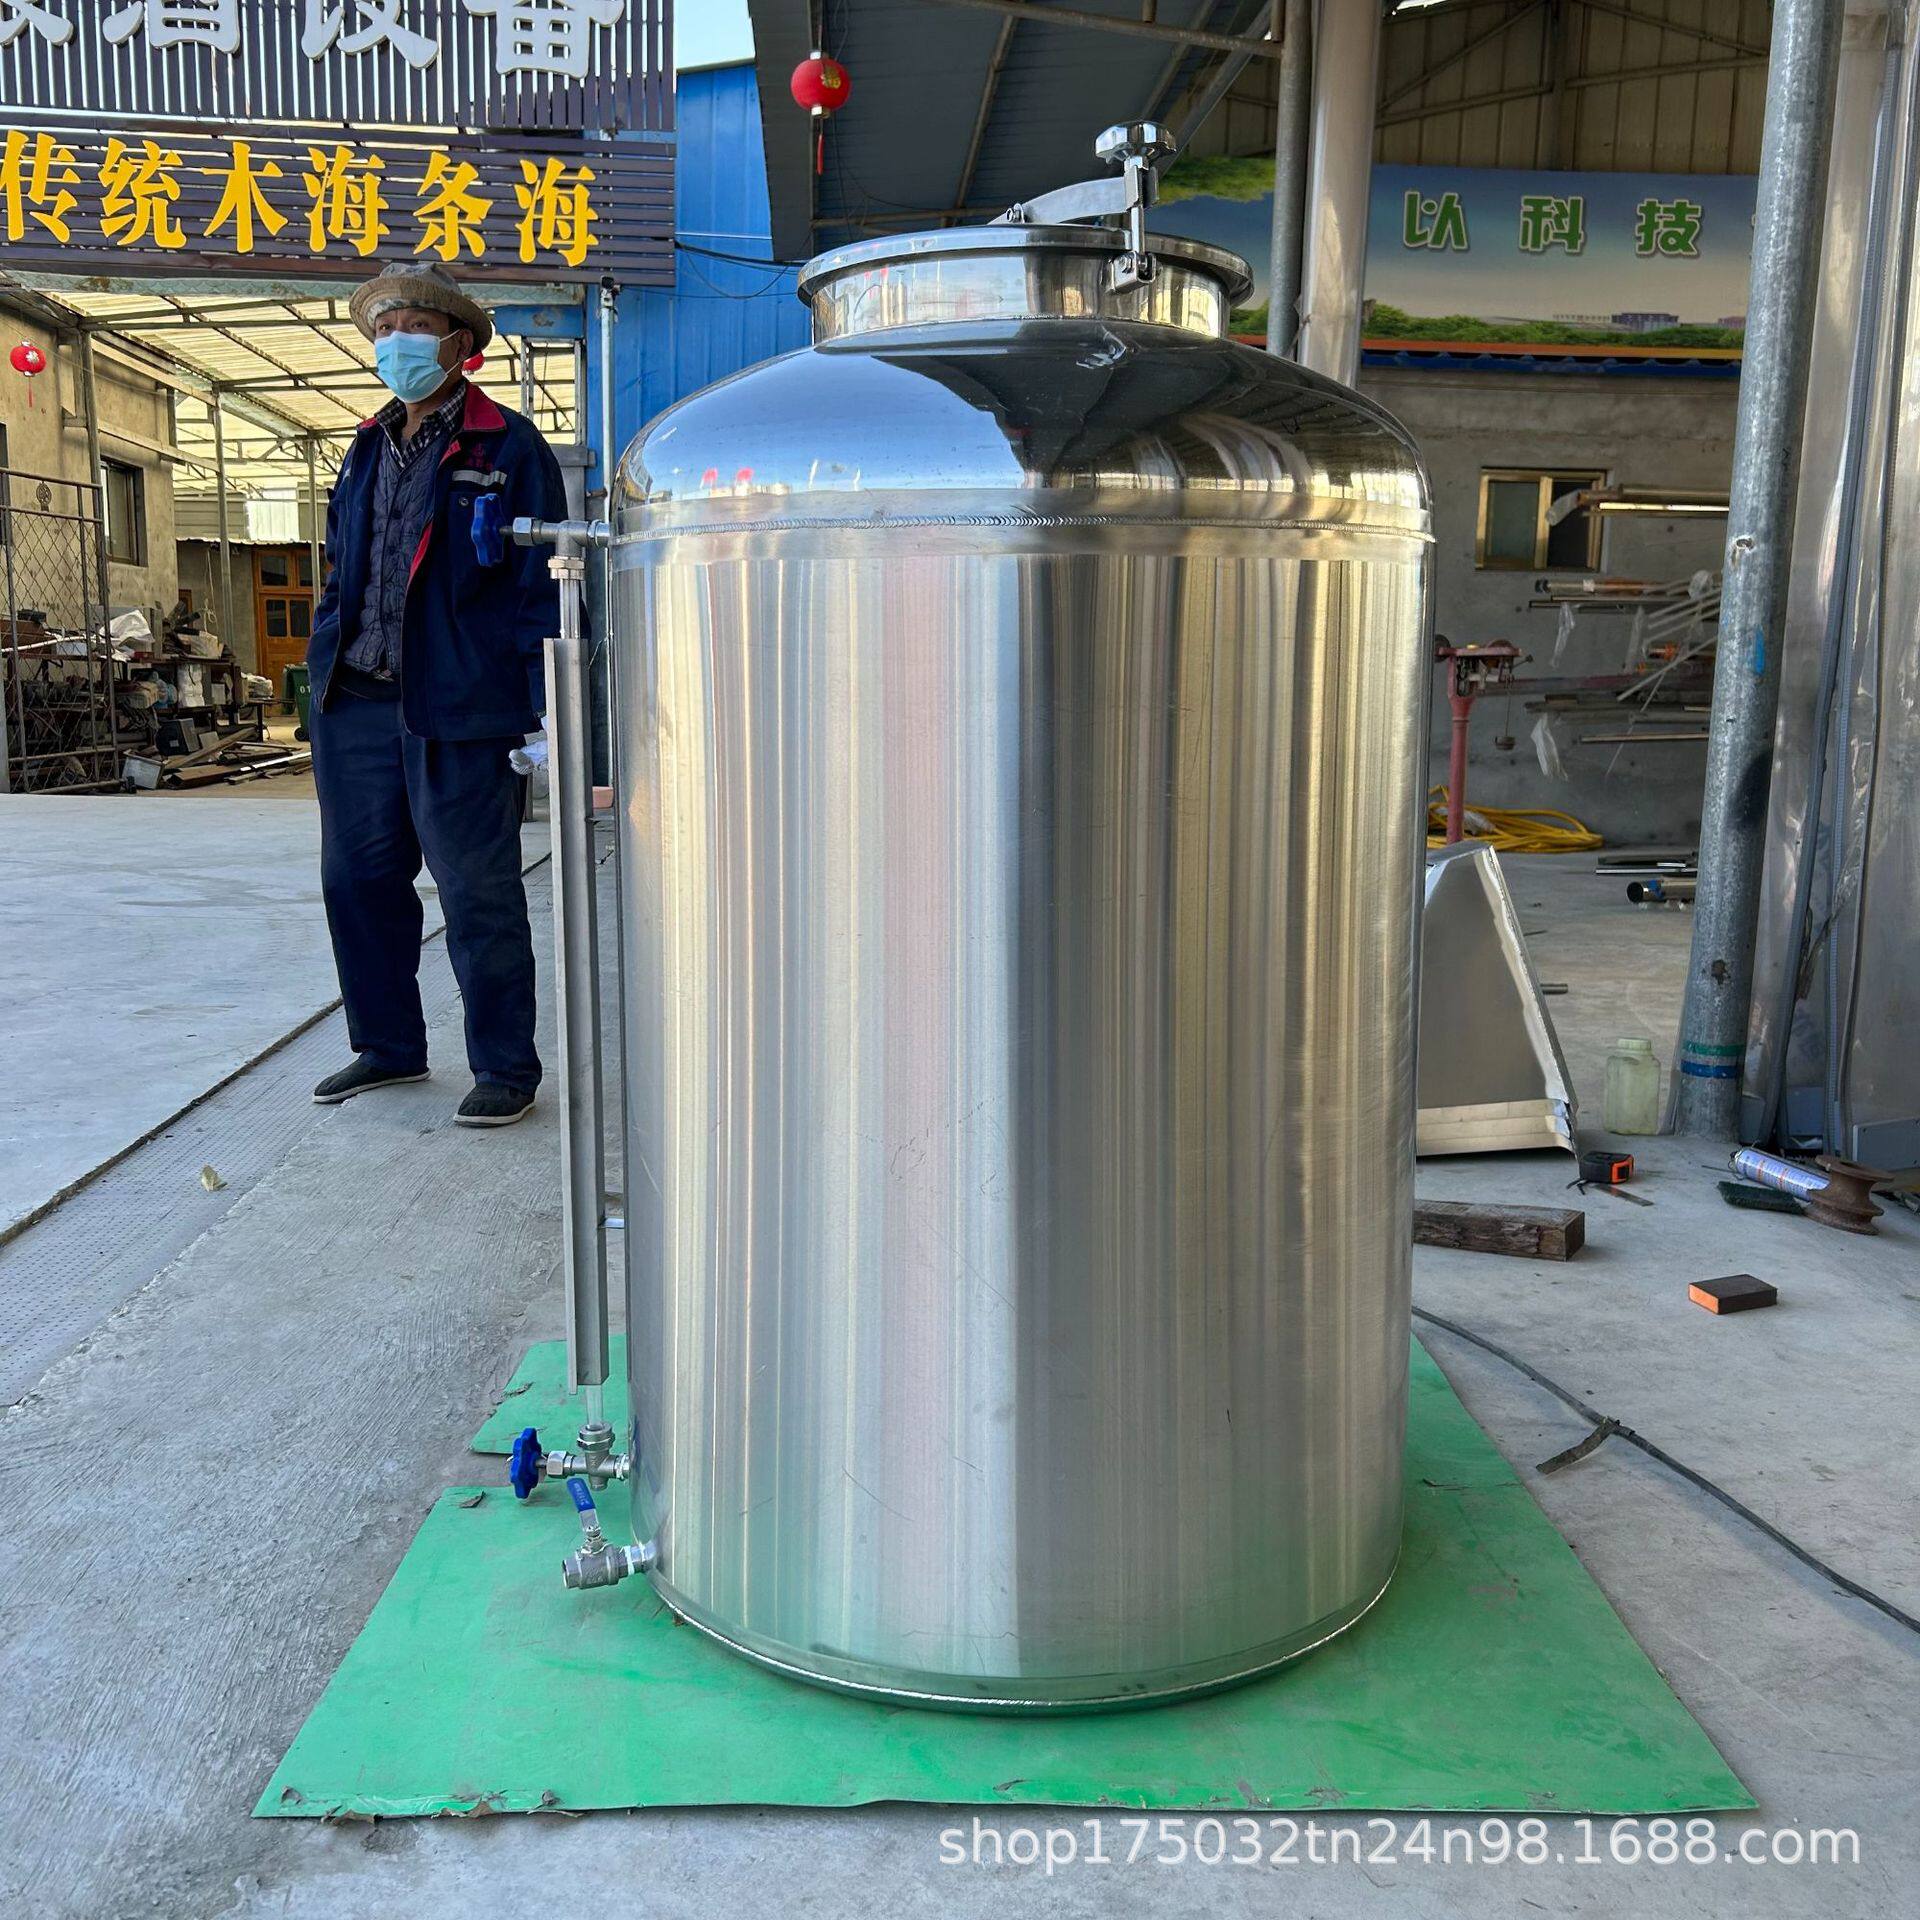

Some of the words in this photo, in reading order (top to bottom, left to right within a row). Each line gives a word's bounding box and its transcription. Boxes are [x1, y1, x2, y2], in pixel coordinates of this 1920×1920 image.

[0, 129, 599, 267] 传统木海条海
